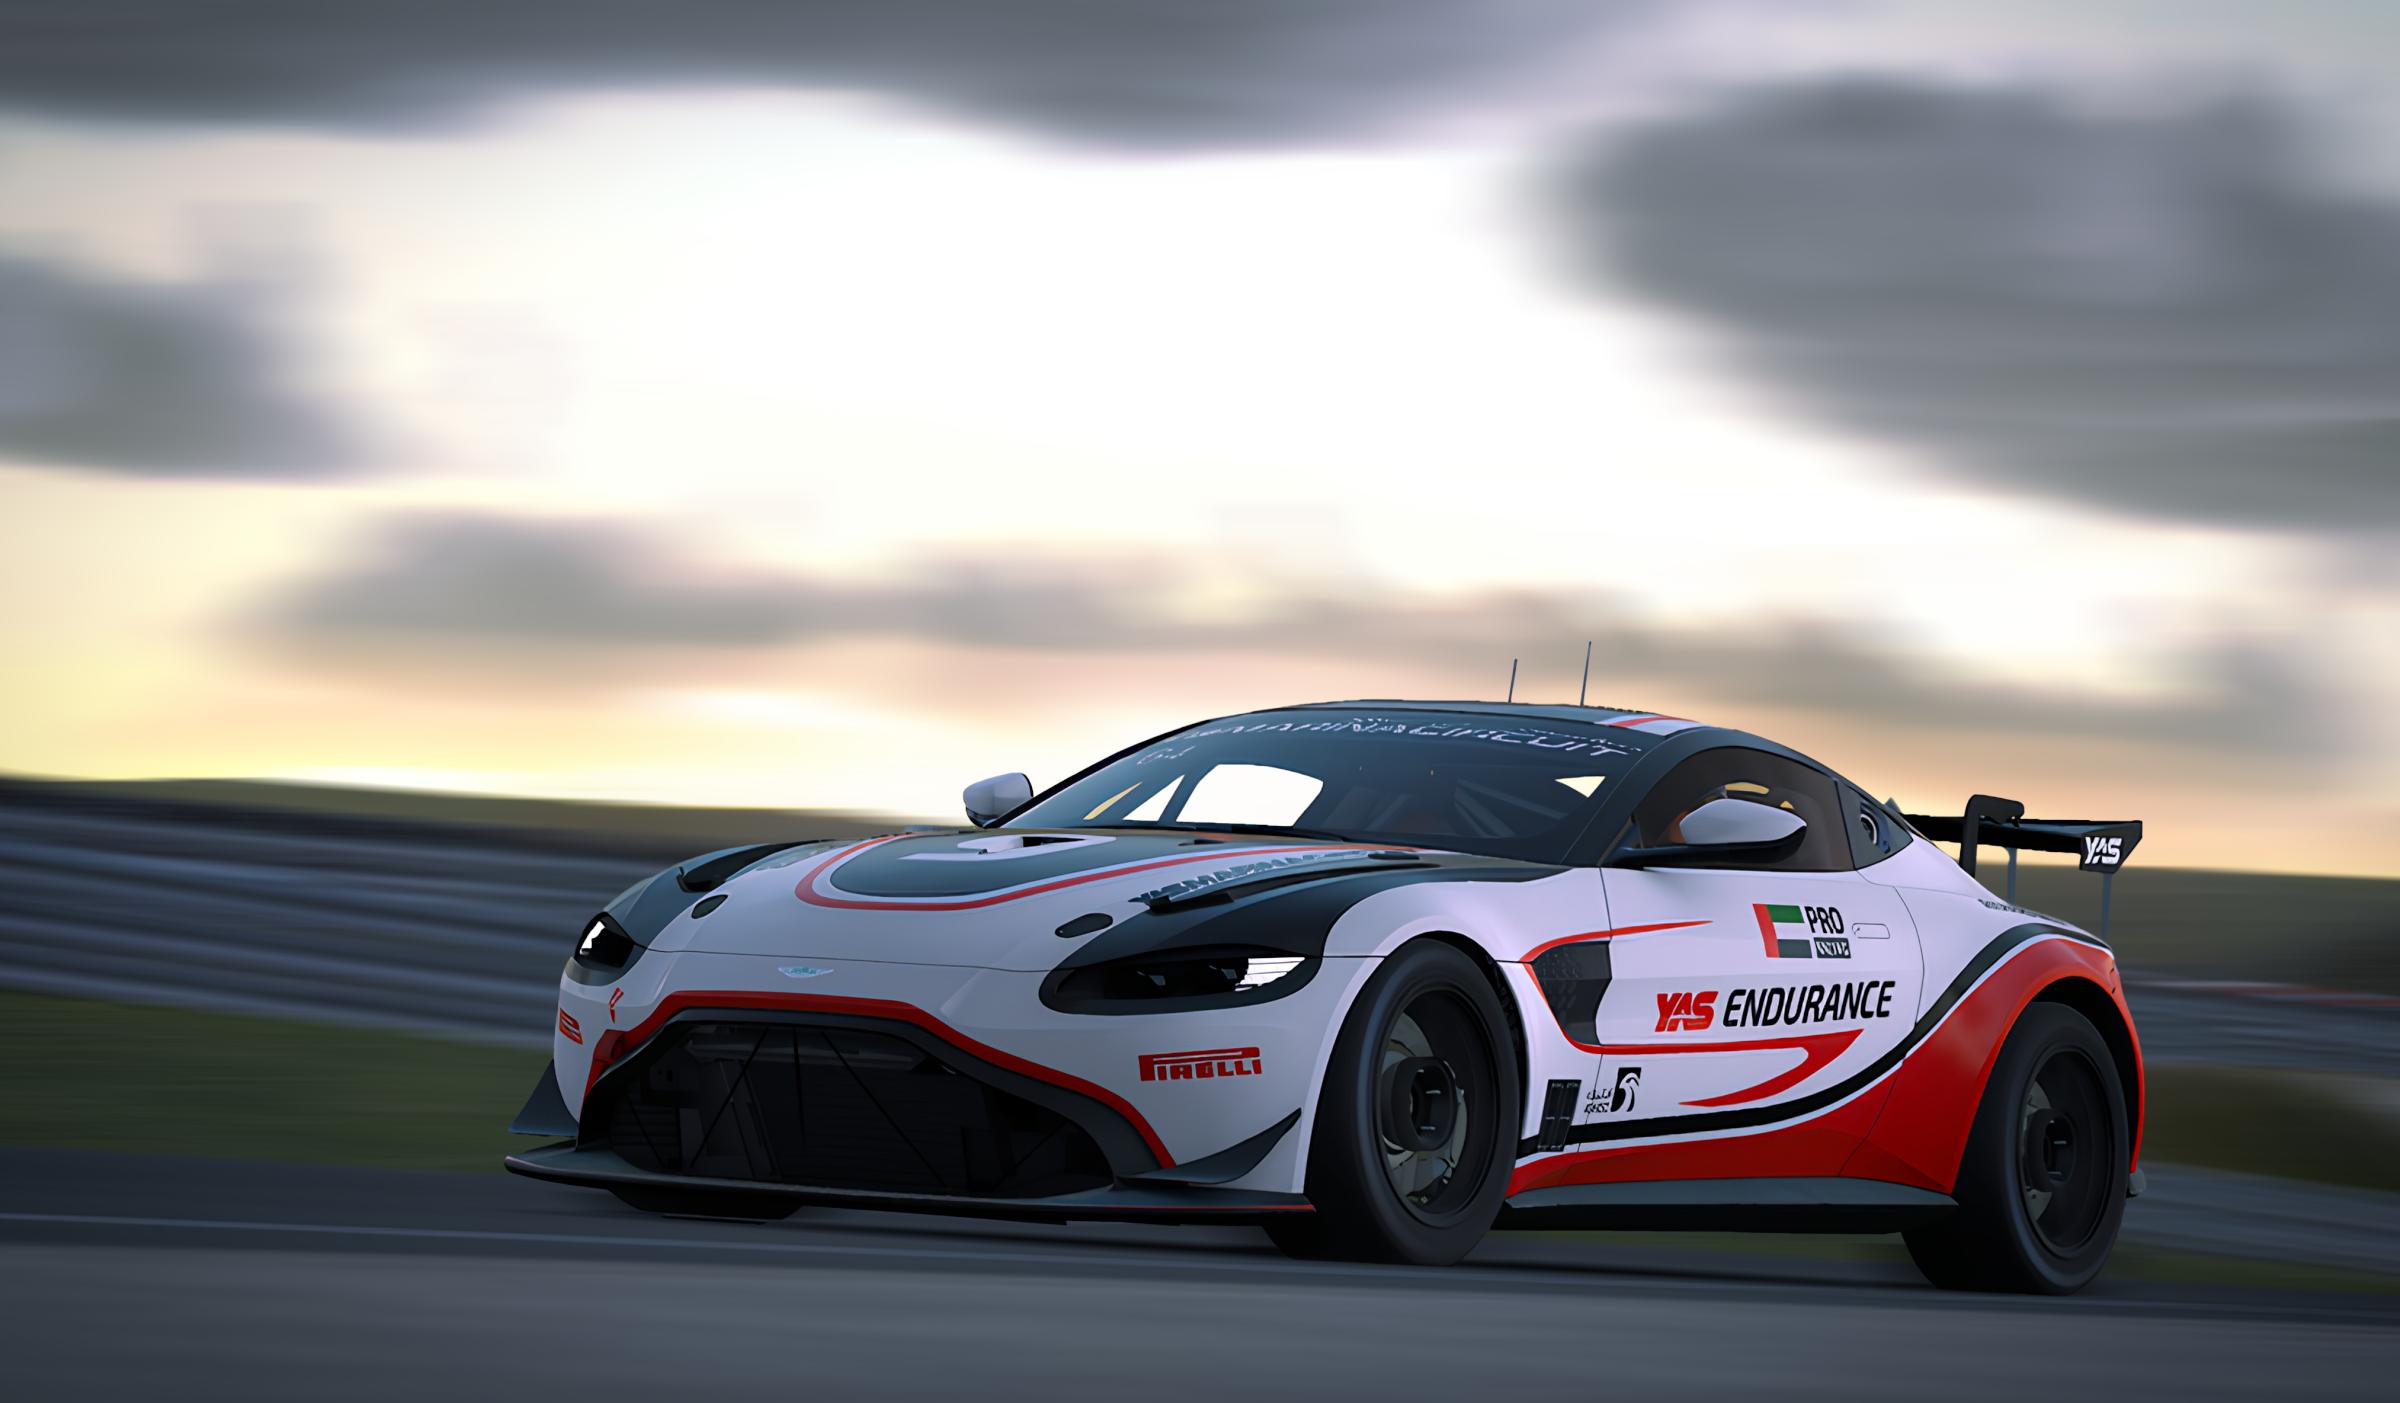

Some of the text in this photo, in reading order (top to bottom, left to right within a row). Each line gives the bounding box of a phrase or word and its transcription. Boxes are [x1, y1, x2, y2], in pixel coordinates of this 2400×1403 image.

[2084, 836, 2122, 865] YAS
[1804, 906, 1845, 934] PRO
[1655, 980, 1896, 1032] YAS ENDURANCE
